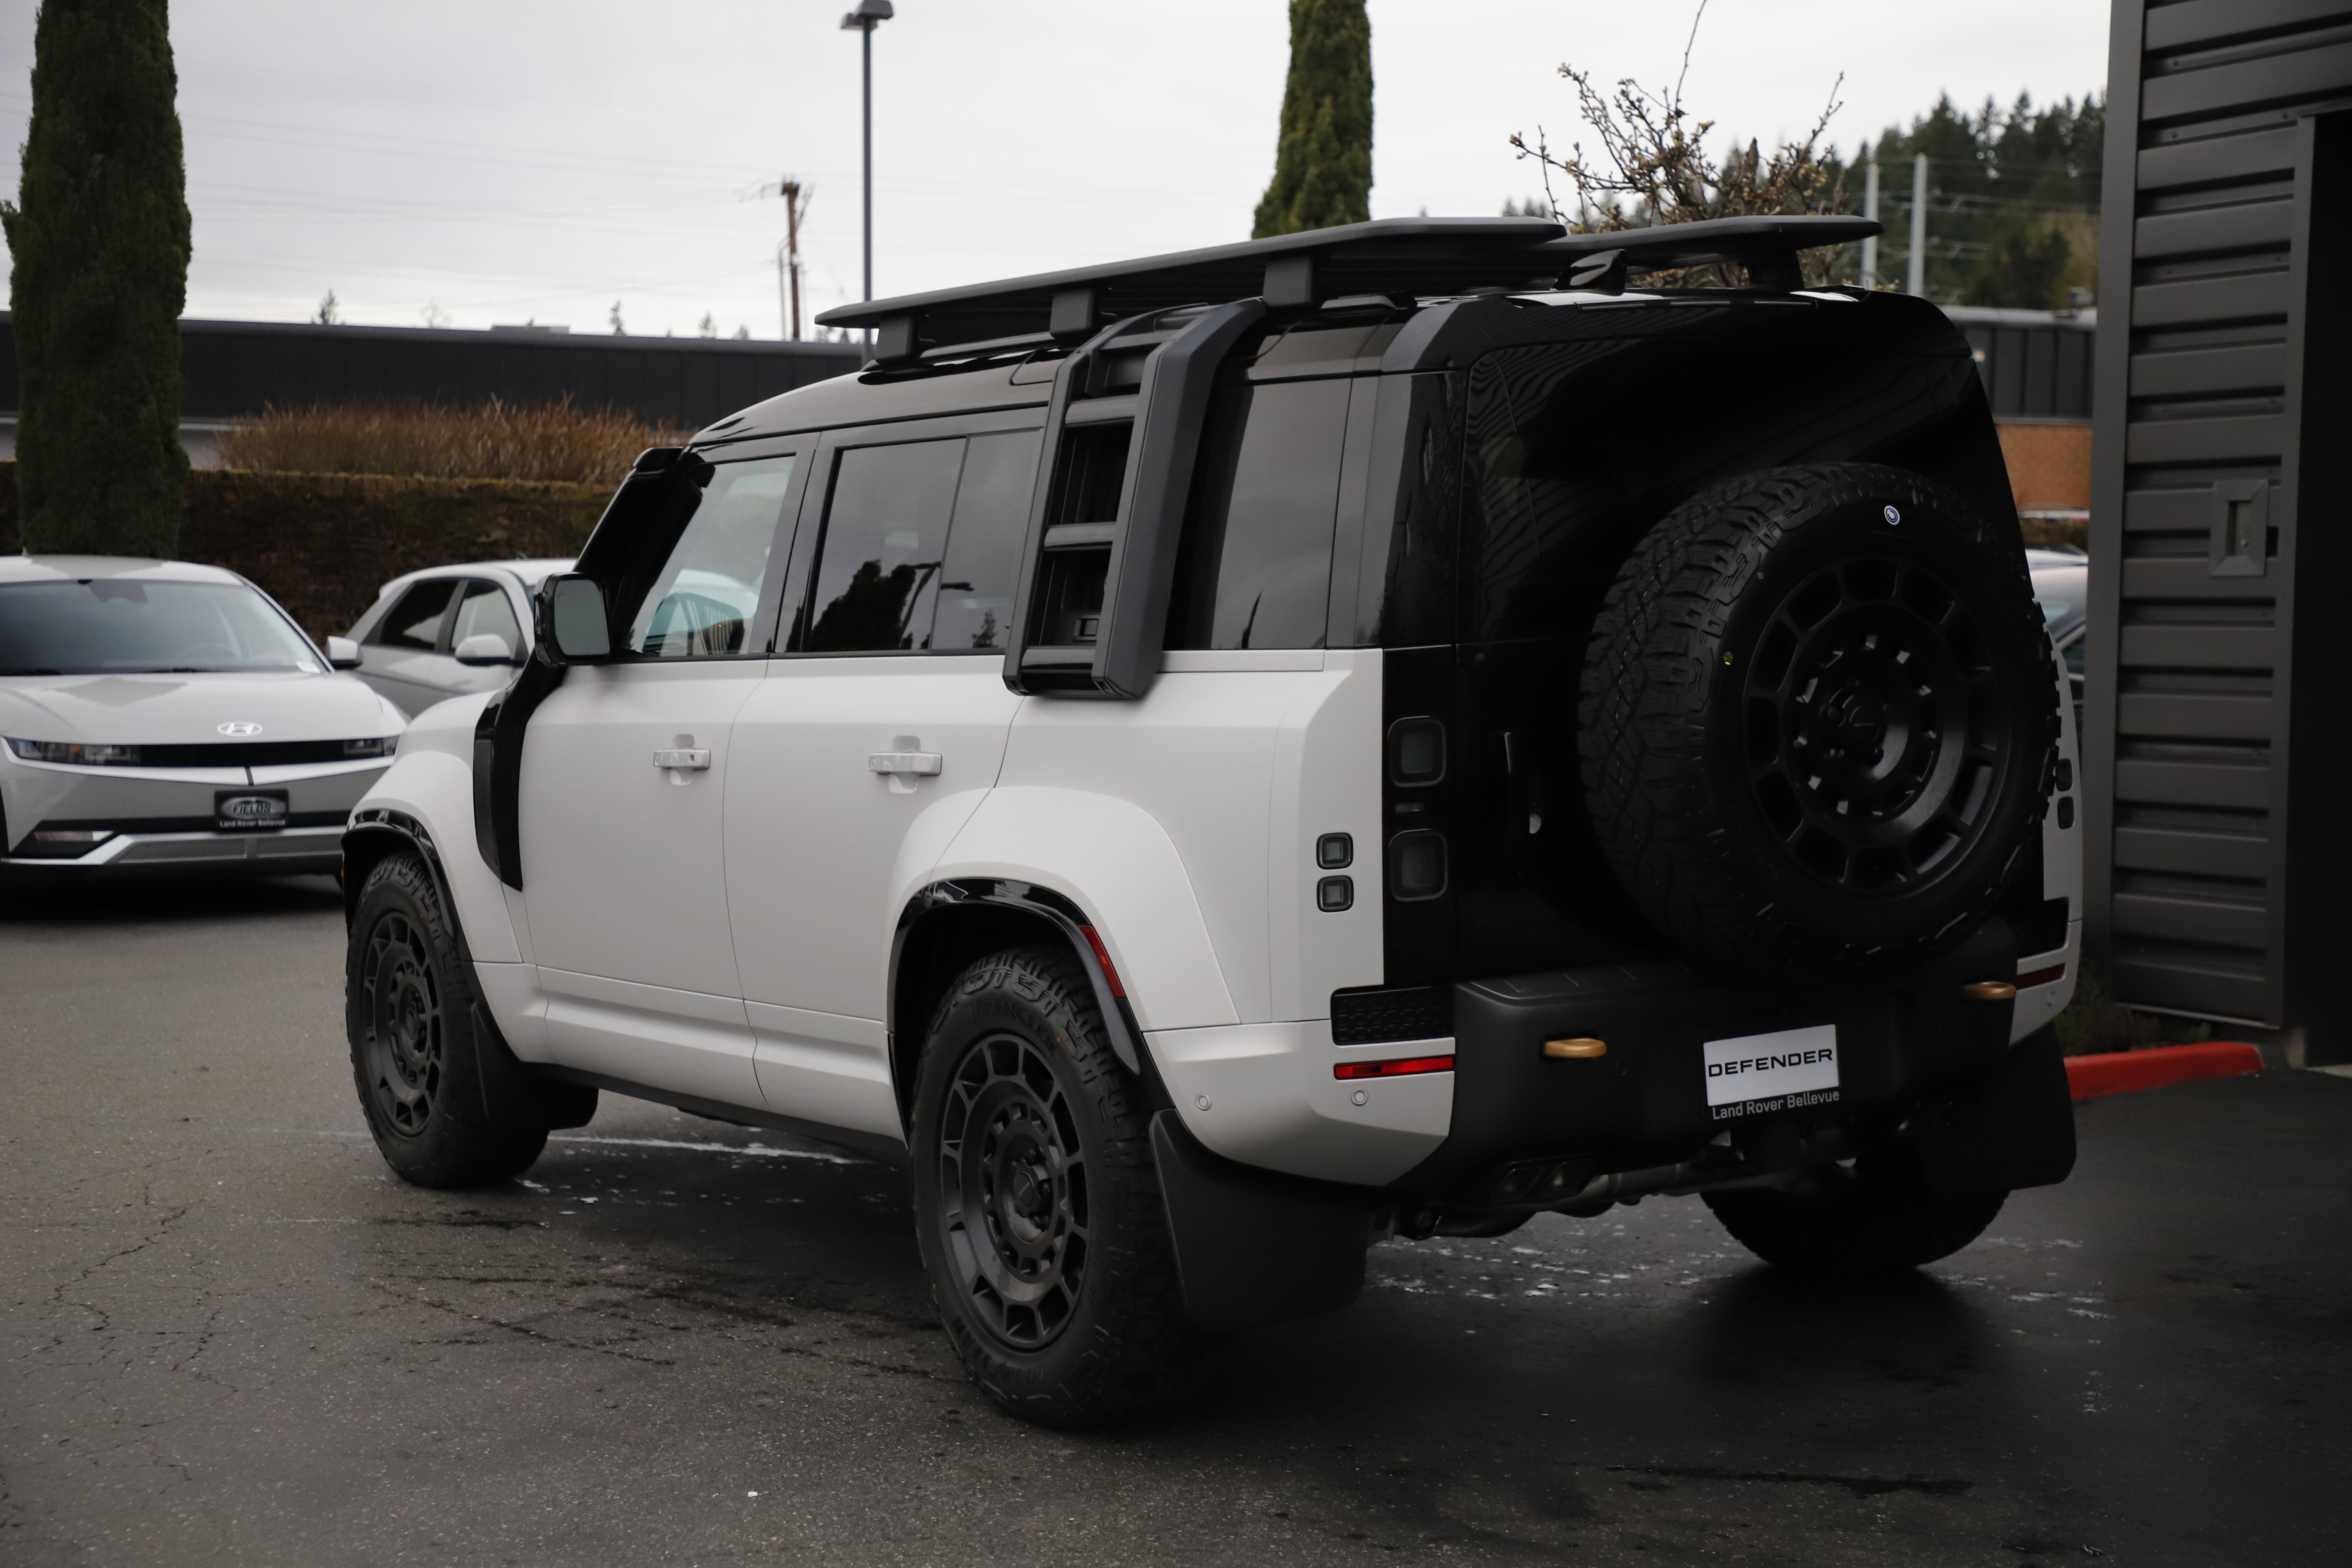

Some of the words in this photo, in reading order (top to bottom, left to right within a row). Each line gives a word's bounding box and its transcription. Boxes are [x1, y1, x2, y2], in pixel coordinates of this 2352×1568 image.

[1708, 1048, 1833, 1077] DEFENDER
[1712, 1102, 1743, 1120] Land
[1746, 1098, 1784, 1115] Rover
[1787, 1091, 1840, 1108] Bellevue
